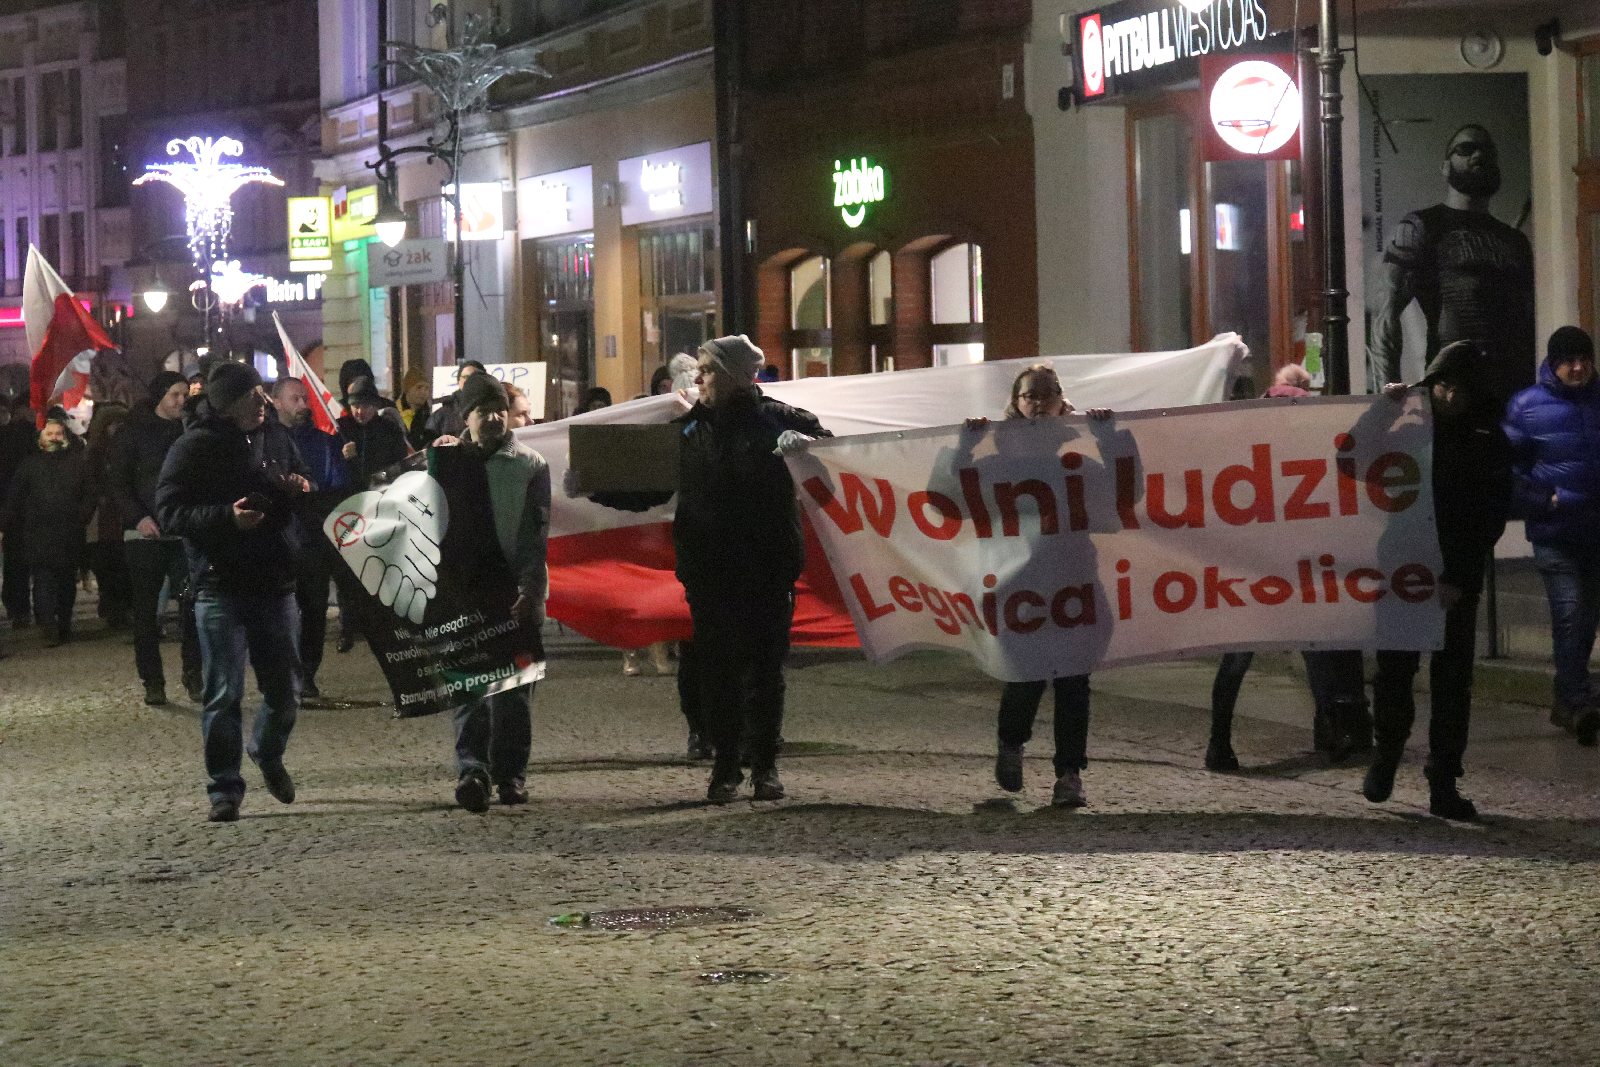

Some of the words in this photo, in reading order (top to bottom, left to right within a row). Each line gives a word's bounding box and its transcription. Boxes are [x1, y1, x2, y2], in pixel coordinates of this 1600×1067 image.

[1102, 9, 1175, 78] PITBULL
[832, 156, 885, 207] żabka
[448, 366, 529, 387] SOP
[804, 452, 1089, 540] Wolni
[1115, 433, 1421, 530] ludzie
[849, 574, 1097, 637] Legnica
[1115, 558, 1132, 621] i
[1152, 553, 1436, 614] okolice
[425, 626, 438, 639] Nie
[465, 663, 516, 692] prostu!
